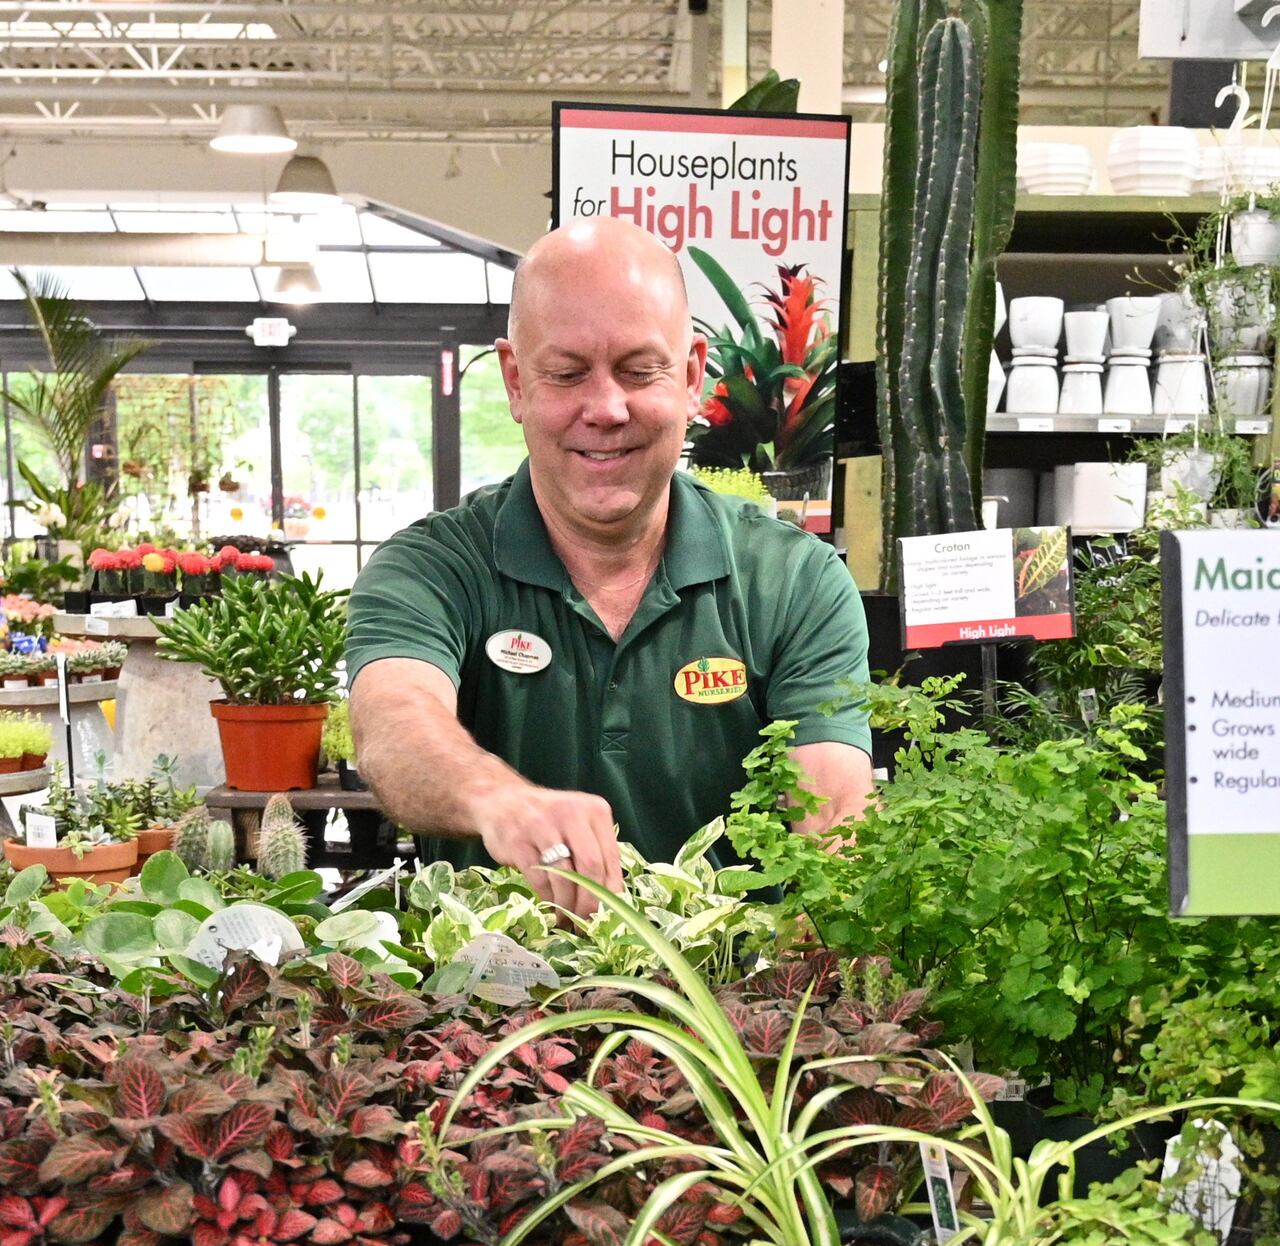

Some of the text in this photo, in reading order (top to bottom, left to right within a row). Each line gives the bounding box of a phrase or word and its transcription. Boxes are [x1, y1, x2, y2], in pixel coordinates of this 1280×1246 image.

[612, 139, 798, 190] Houseplants
[573, 183, 832, 256] for High Light
[934, 542, 971, 554] Croton
[1195, 608, 1270, 627] Delicate
[960, 624, 1016, 640] High Light
[511, 638, 533, 650] PIKE
[682, 669, 746, 696] PIKE
[698, 687, 743, 697] NURSERIES
[1212, 718, 1275, 737] Grows
[1213, 741, 1259, 760] wide
